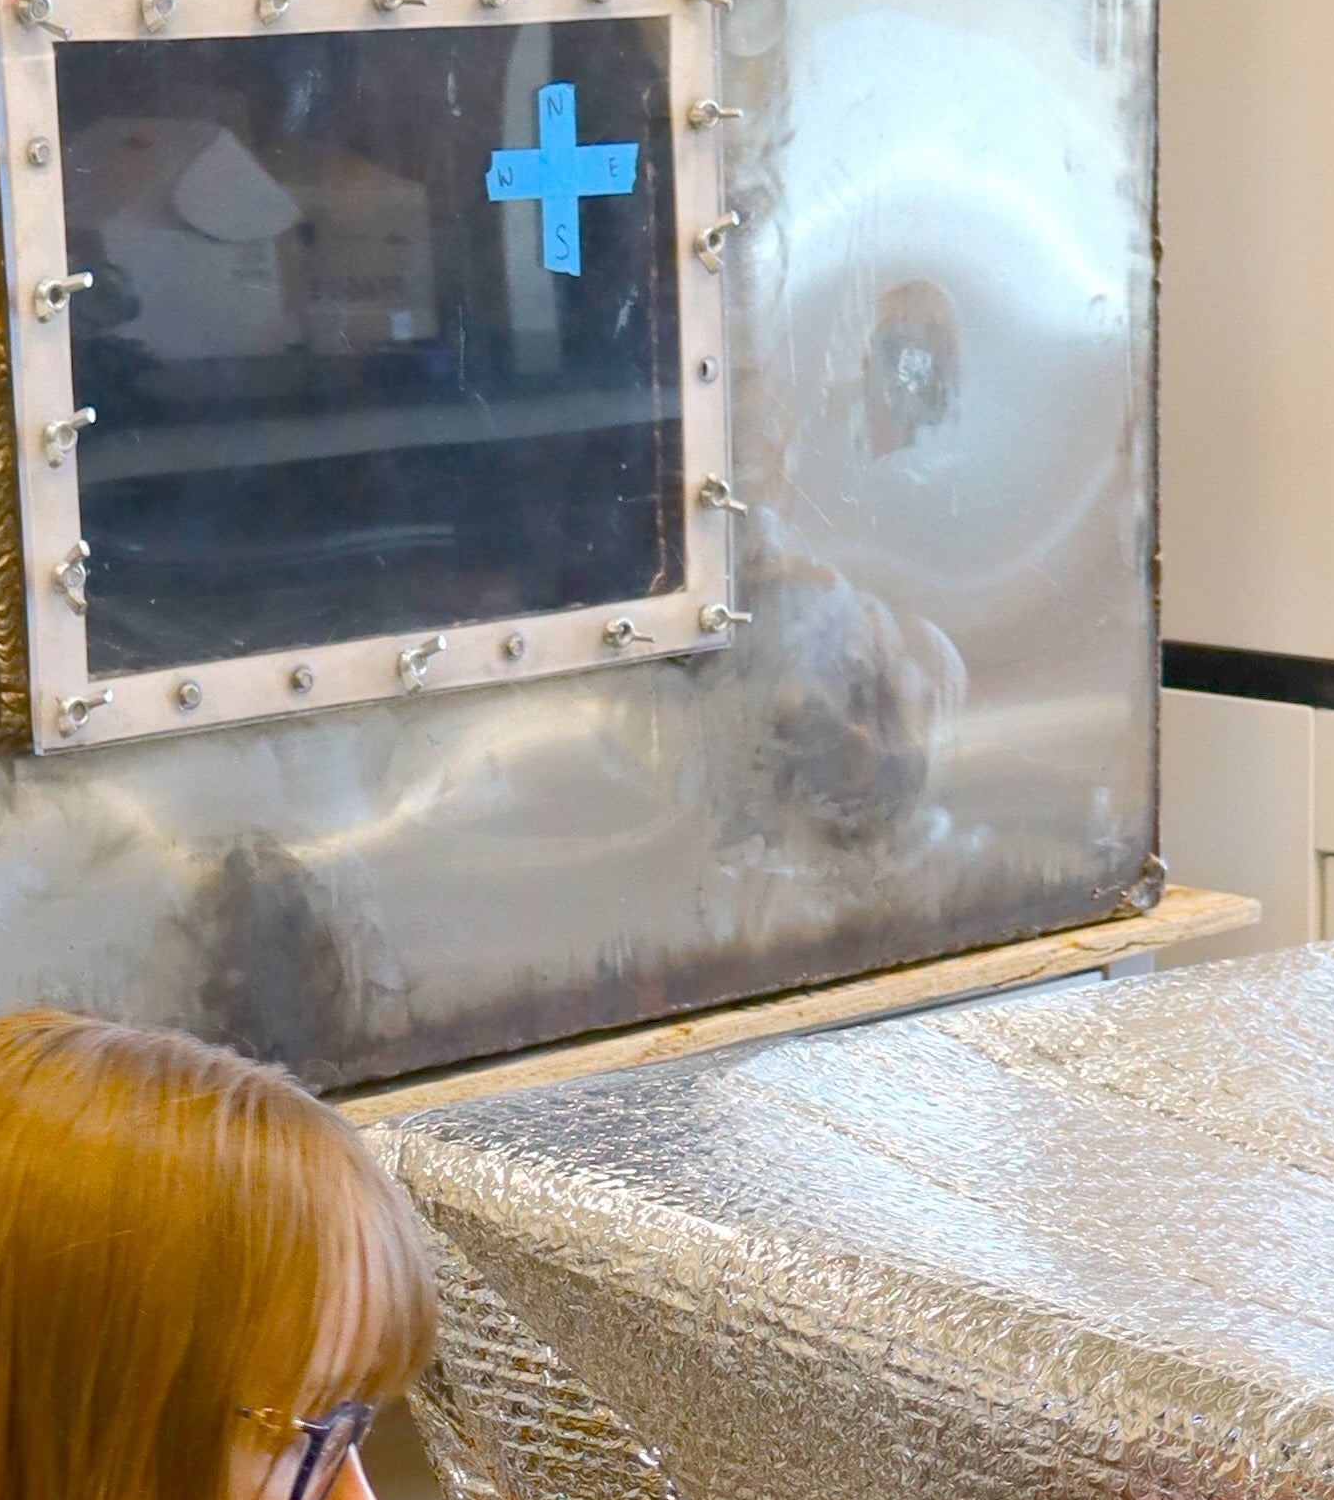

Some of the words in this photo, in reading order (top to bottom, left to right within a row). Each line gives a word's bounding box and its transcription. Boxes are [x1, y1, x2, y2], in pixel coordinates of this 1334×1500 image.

[546, 93, 565, 118] N
[496, 166, 514, 187] W
[608, 157, 618, 177] E
[556, 224, 569, 260] S
